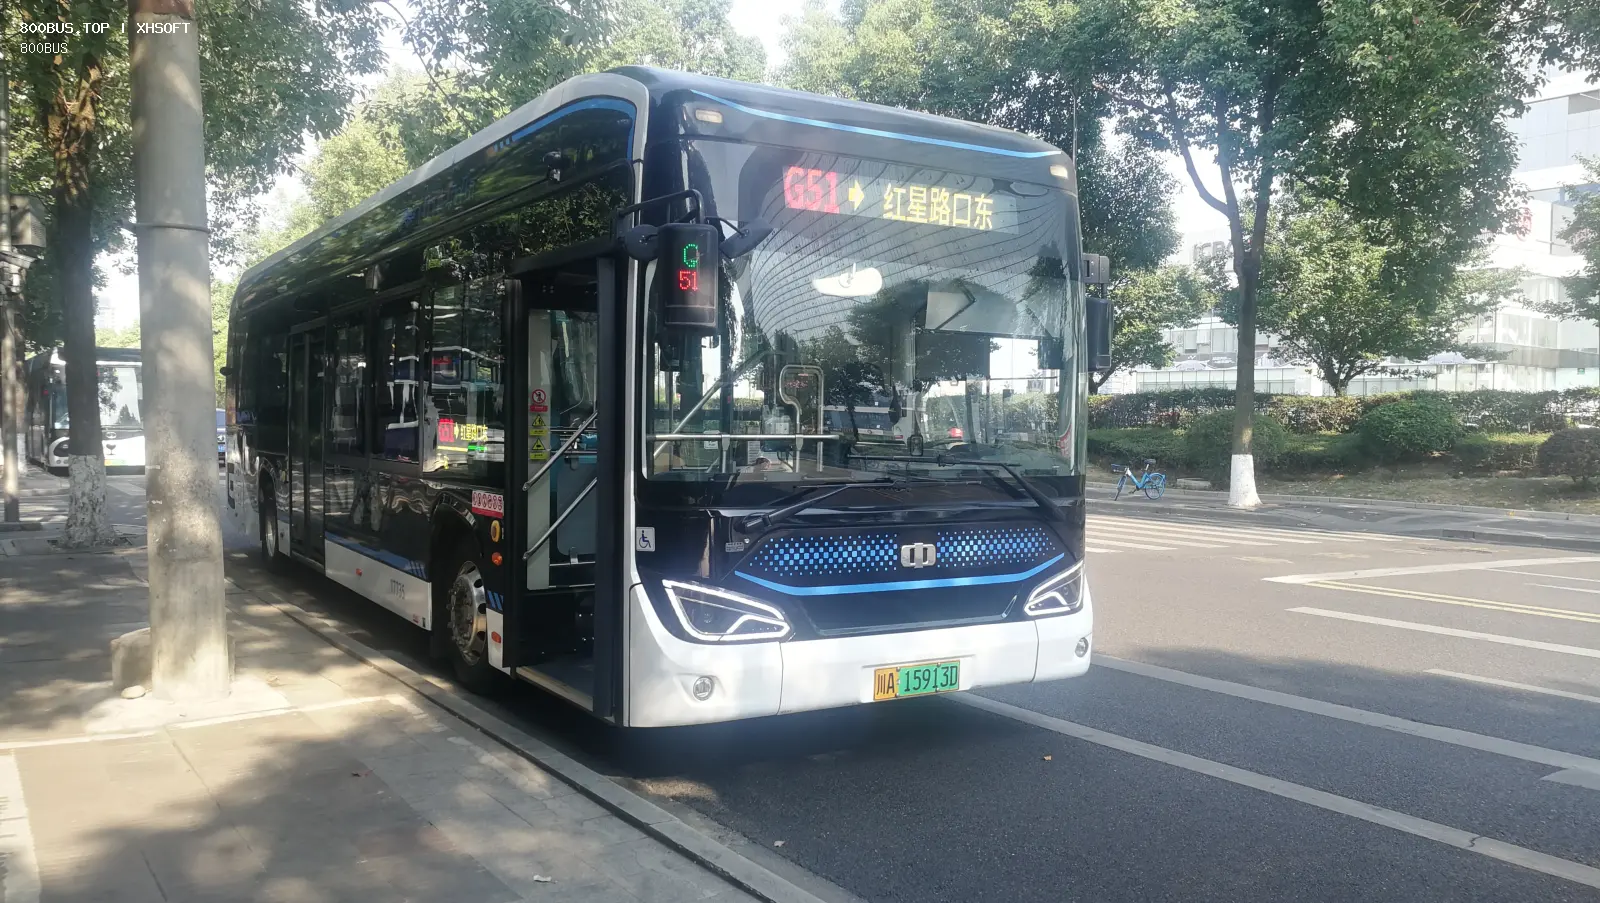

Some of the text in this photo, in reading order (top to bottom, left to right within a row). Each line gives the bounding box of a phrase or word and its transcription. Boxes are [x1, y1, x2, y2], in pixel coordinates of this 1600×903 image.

[784, 166, 840, 214] G51
[883, 183, 994, 230] 红星路口东
[683, 243, 698, 268] G
[679, 270, 698, 291] 51
